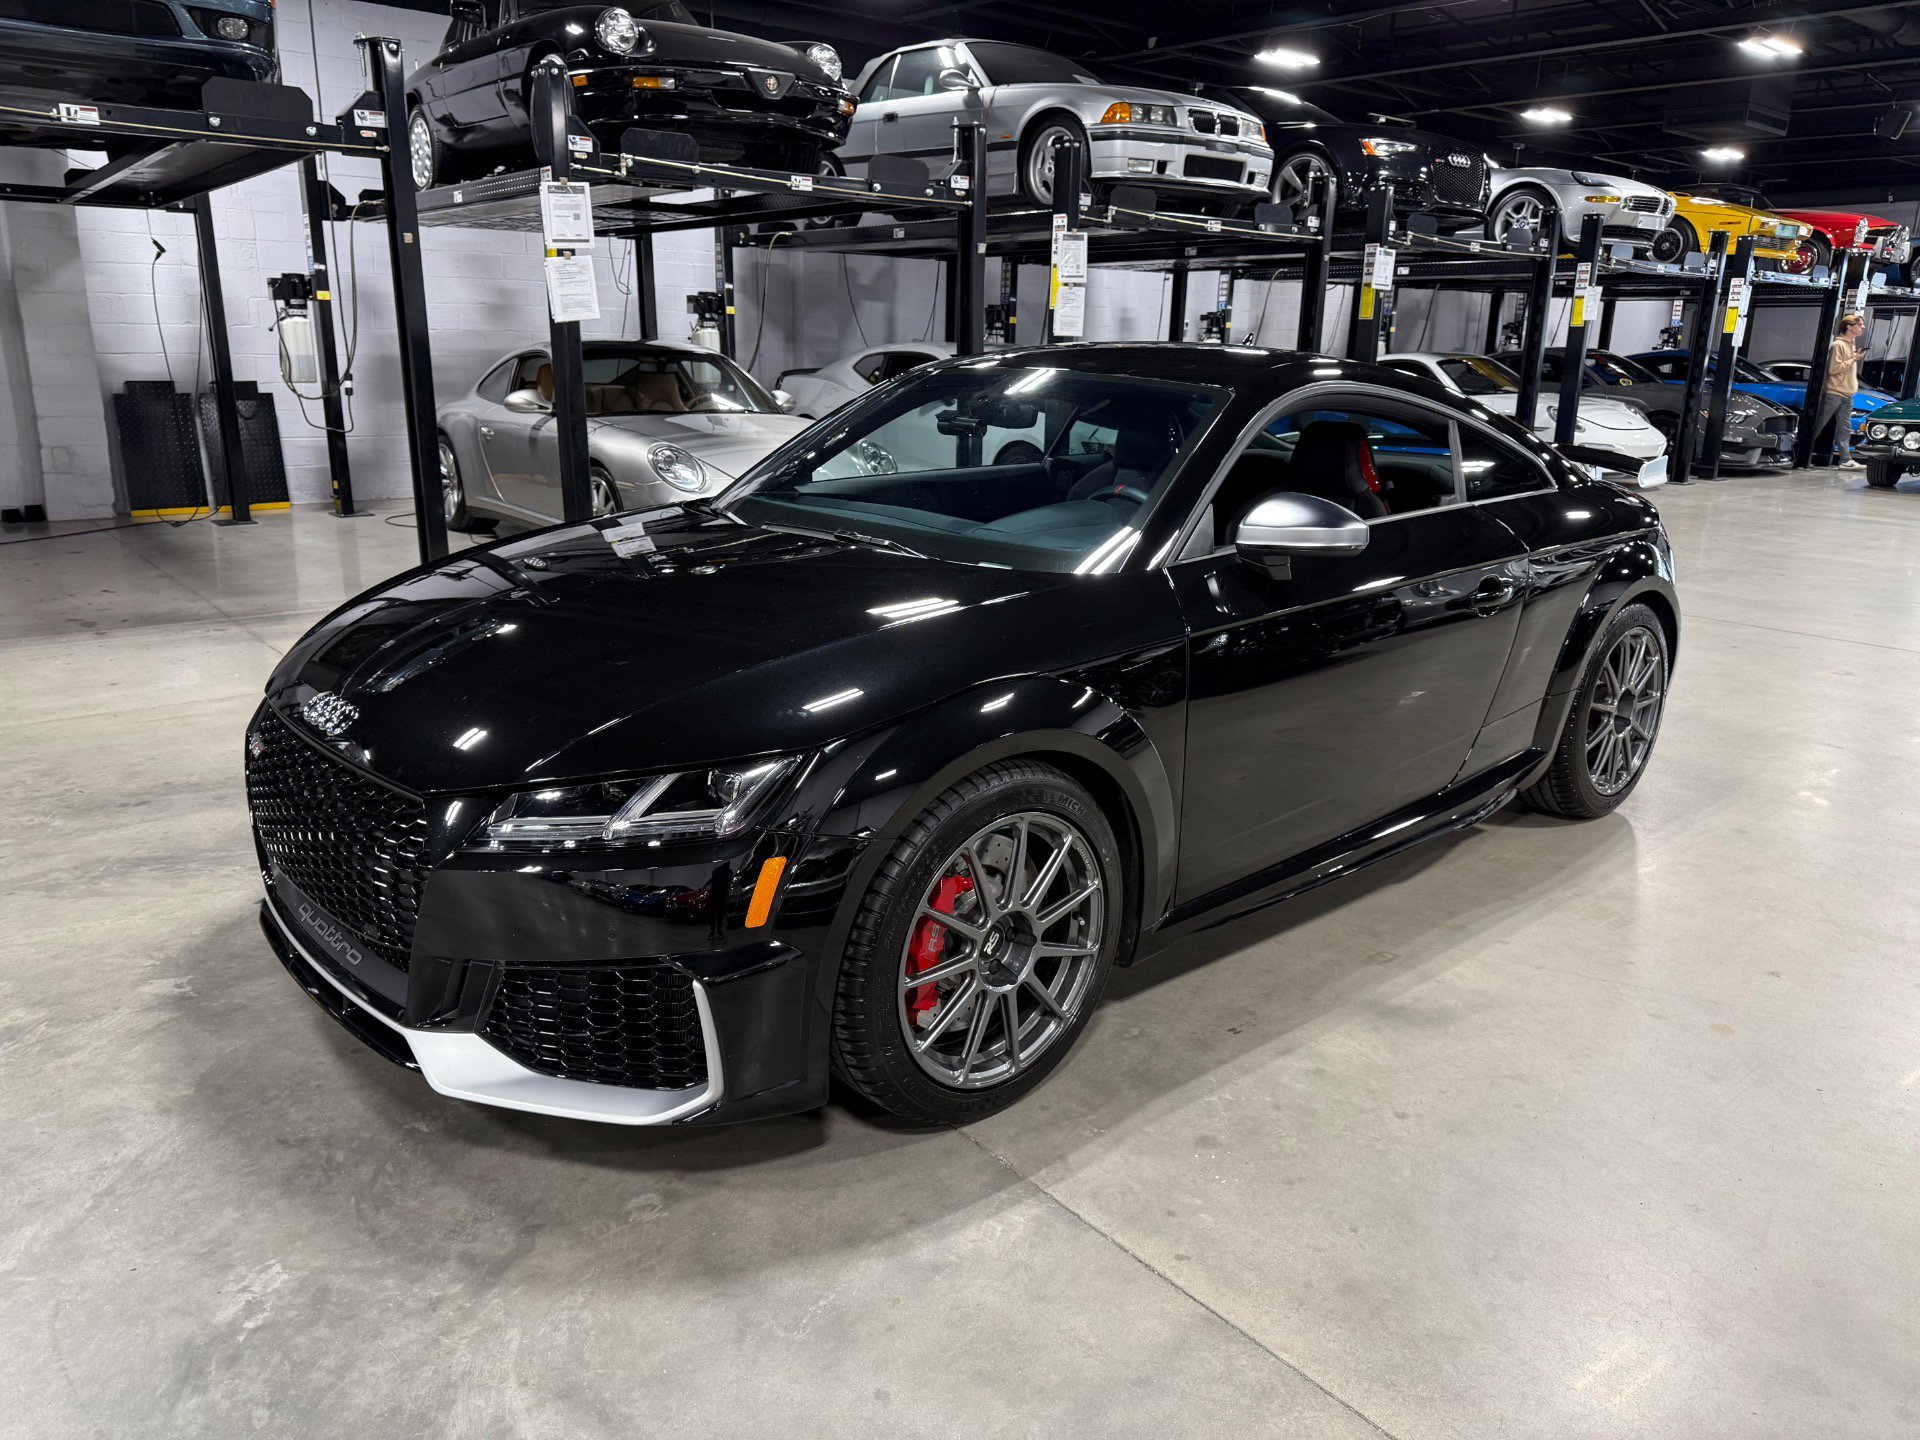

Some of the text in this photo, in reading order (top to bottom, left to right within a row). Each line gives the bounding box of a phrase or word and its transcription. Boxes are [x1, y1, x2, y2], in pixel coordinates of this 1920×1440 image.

[298, 902, 363, 965] quattro
[927, 923, 942, 953] RS
[983, 930, 1000, 956] RS
